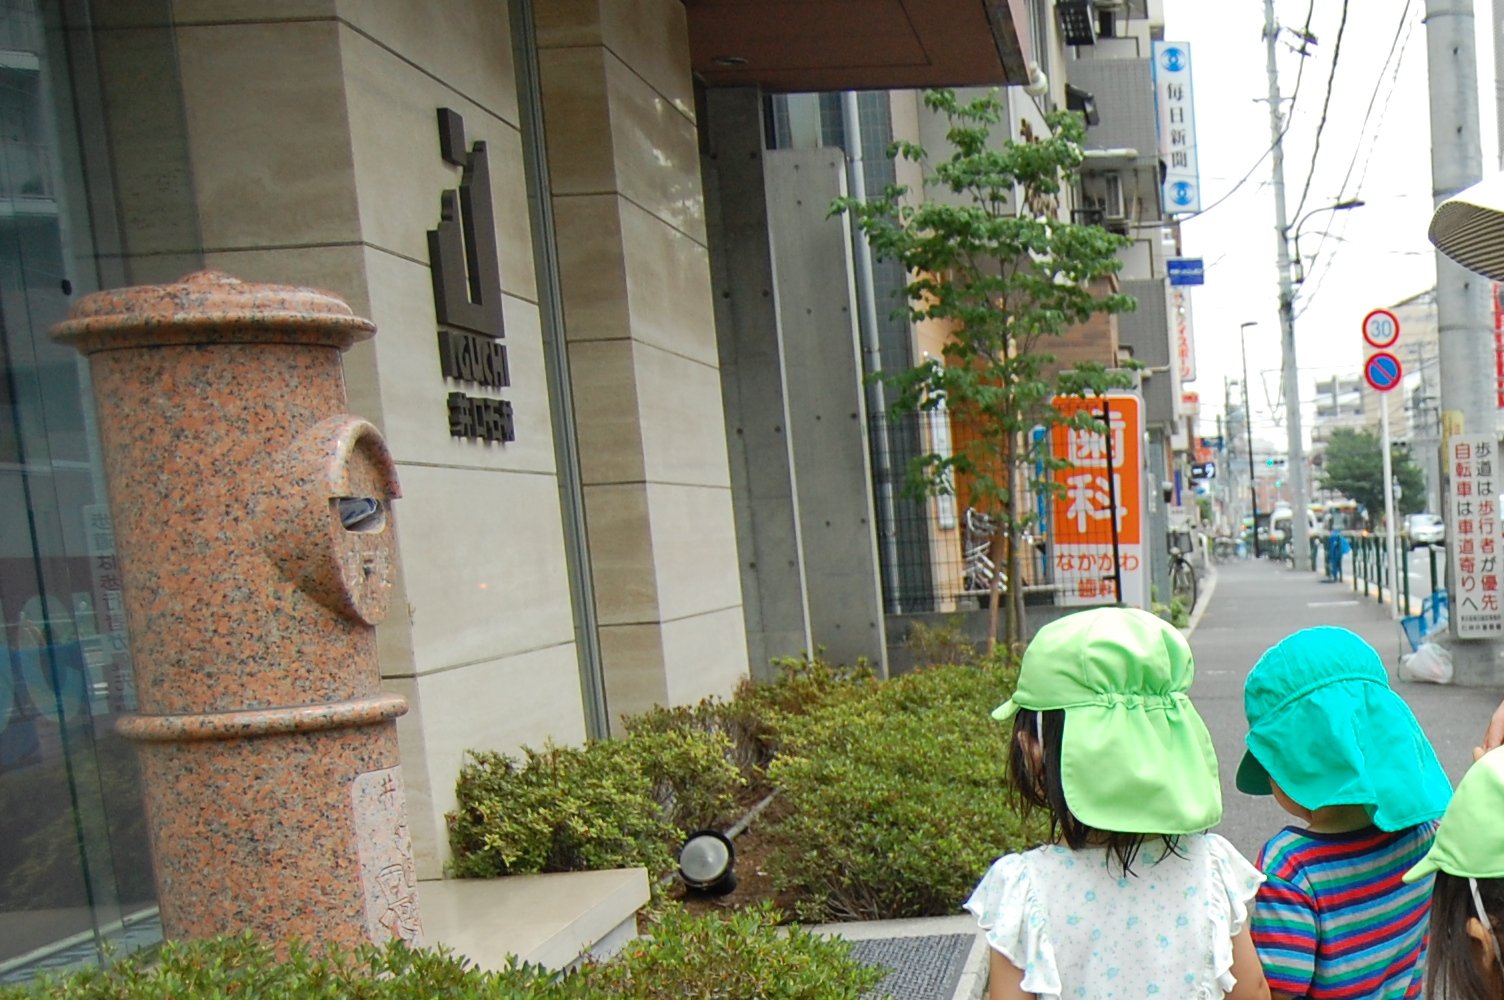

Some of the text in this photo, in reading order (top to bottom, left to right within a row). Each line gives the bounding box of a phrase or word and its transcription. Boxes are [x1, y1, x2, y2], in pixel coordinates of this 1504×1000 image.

[1167, 82, 1188, 168] 毎日新聞
[438, 331, 510, 387] IGUCHI
[1371, 320, 1391, 337] 30
[1067, 409, 1127, 532] 歯科
[1456, 443, 1479, 611] 自転車は車道寄りへ
[1475, 442, 1499, 611] 歩道は歩行者が優先
